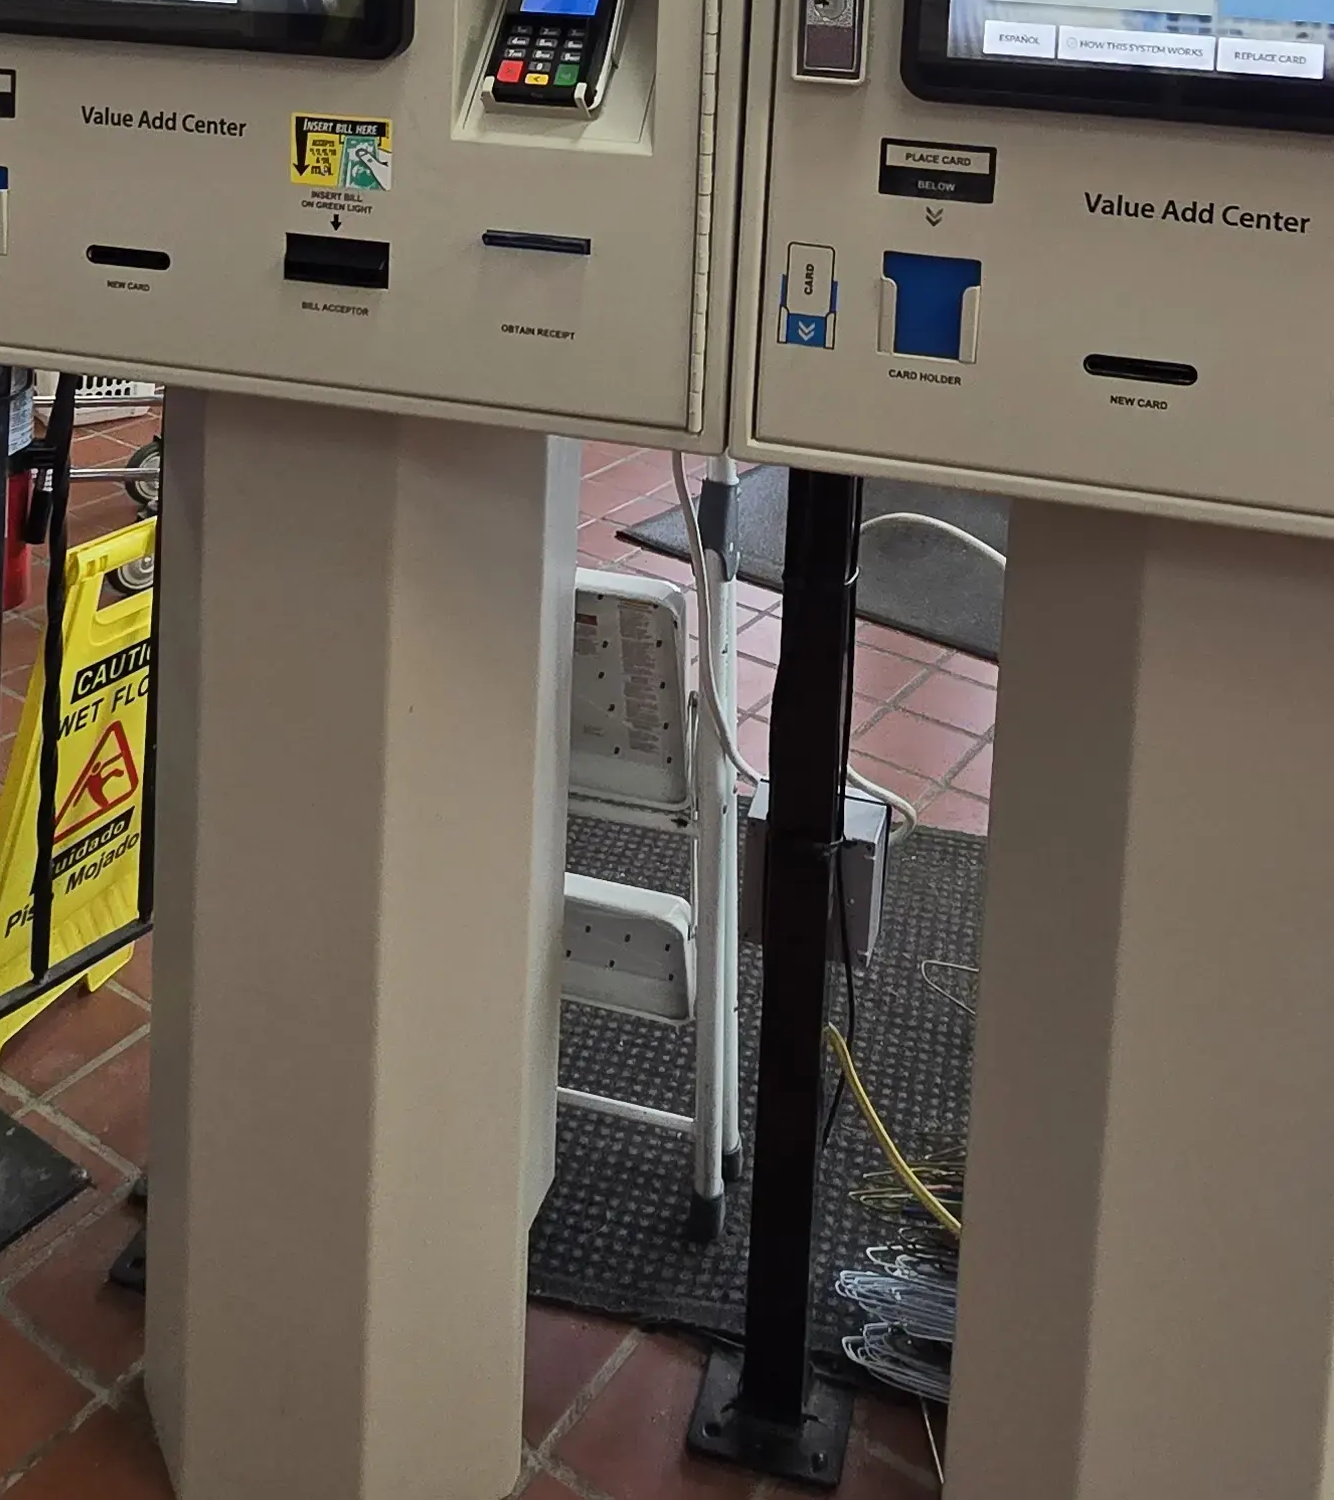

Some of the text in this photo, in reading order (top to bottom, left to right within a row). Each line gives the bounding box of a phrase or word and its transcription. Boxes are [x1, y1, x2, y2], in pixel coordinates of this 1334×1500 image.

[1079, 40, 1204, 57] HOW THIS SYSTEM WORKS
[1234, 51, 1306, 65] REPLACE CARD
[81, 105, 247, 137] Value Add Center
[303, 118, 378, 135] INSERT BILL HERE
[905, 152, 971, 167] PLACE CARD
[917, 180, 956, 192] BELOW
[311, 191, 363, 202] INSERT BILL
[301, 200, 372, 214] ON GREEN LIGHT
[1084, 191, 1310, 234] Value Add Center
[107, 280, 150, 291] NEW CARD
[804, 263, 814, 295] CARD
[302, 301, 369, 316] BILL ACCEPTOR
[501, 323, 575, 340] OBTAIN RECEIPT
[889, 369, 961, 385] CARD HOLDER
[1110, 395, 1168, 410] NEW CARD
[77, 643, 151, 696] CAUTI
[58, 675, 149, 740] WET FLO
[53, 820, 125, 874] uidado
[65, 833, 140, 895] Mojado
